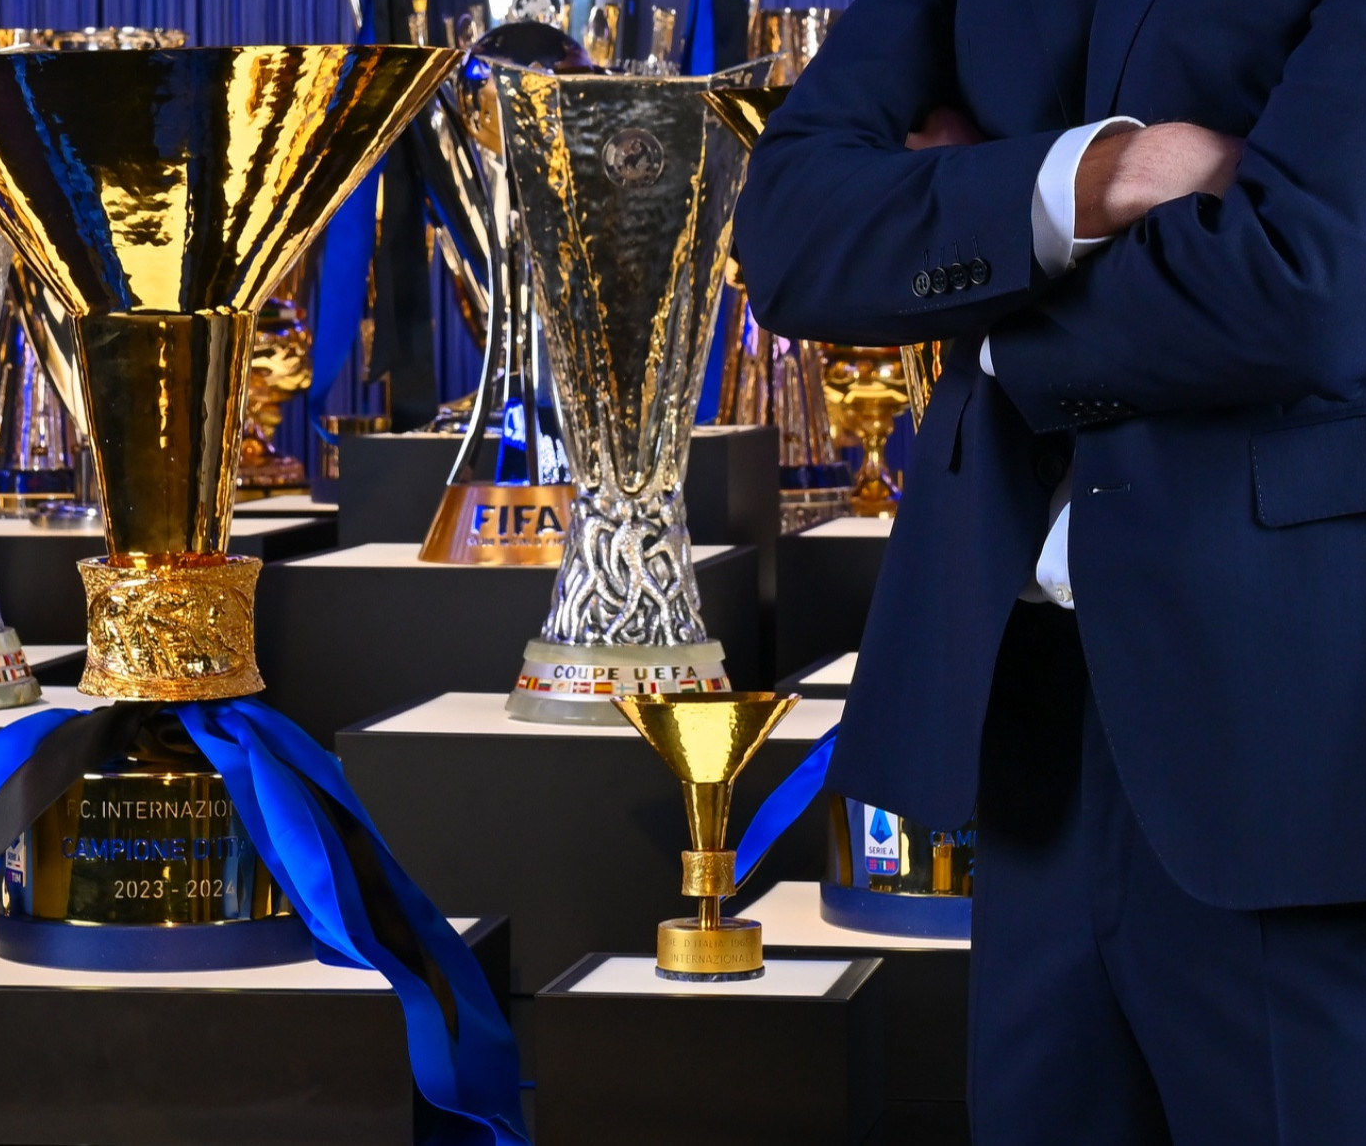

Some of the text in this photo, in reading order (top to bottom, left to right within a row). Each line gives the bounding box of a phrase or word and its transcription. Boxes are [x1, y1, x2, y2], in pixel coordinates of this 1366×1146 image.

[470, 504, 567, 536] FIFA
[553, 664, 698, 681] COUPE UEFA
[61, 836, 186, 862] CAMPIONE
[868, 845, 895, 856] SERIE A
[113, 879, 165, 900] 2023
[186, 878, 235, 899] 2024
